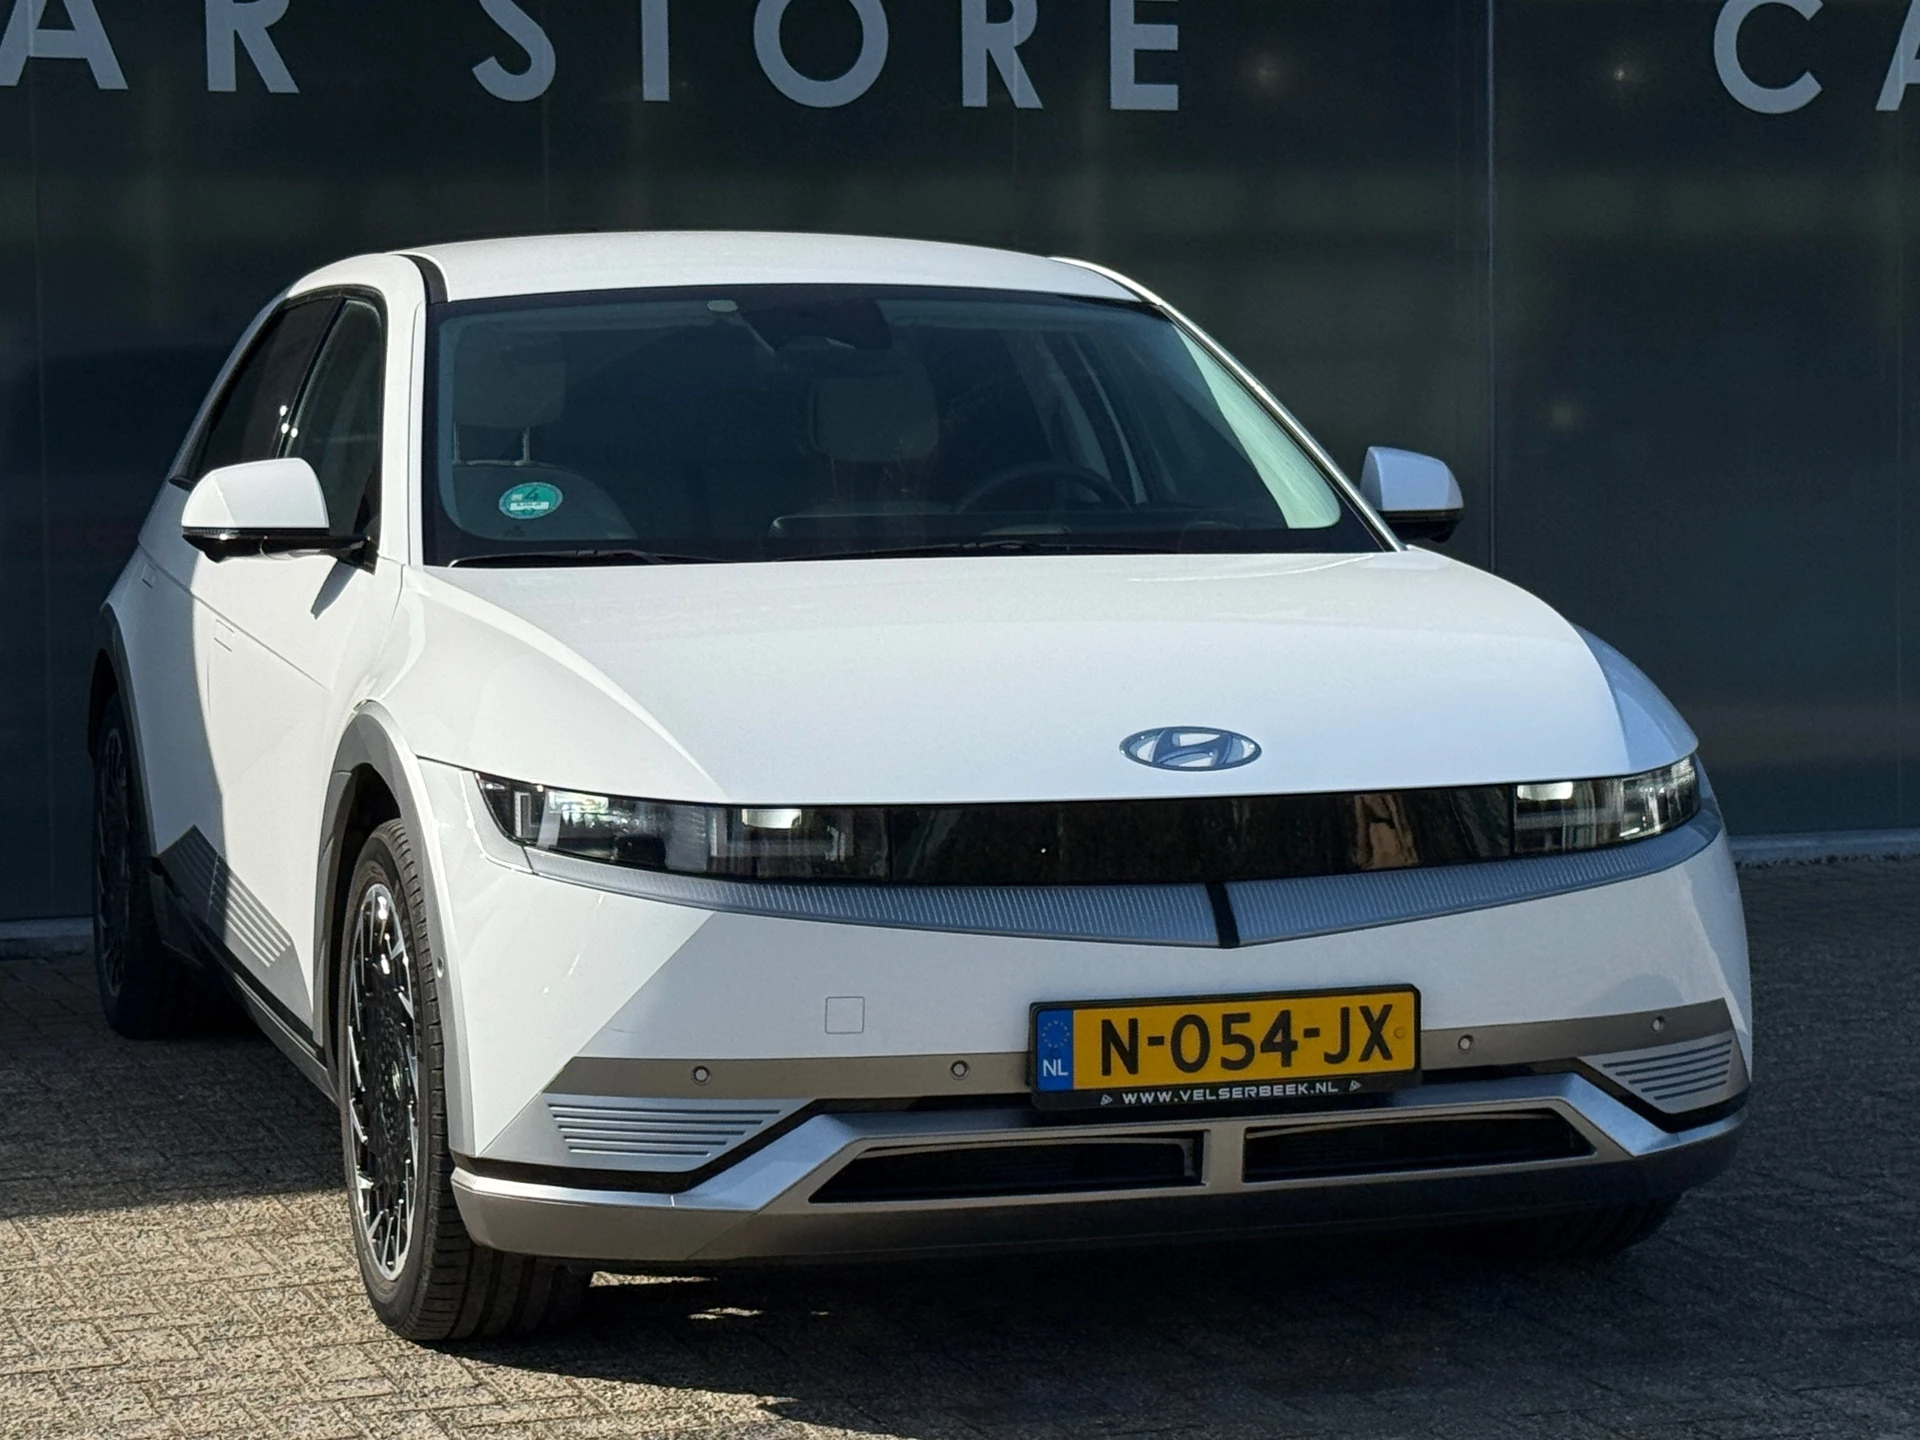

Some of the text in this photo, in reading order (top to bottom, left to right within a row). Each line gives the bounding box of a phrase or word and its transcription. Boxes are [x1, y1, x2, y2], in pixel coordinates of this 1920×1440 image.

[1101, 1003, 1394, 1076] N-054-JX
[1042, 1059, 1069, 1078] NL
[1122, 1082, 1339, 1105] WWW.VELSERBEEK.NL
